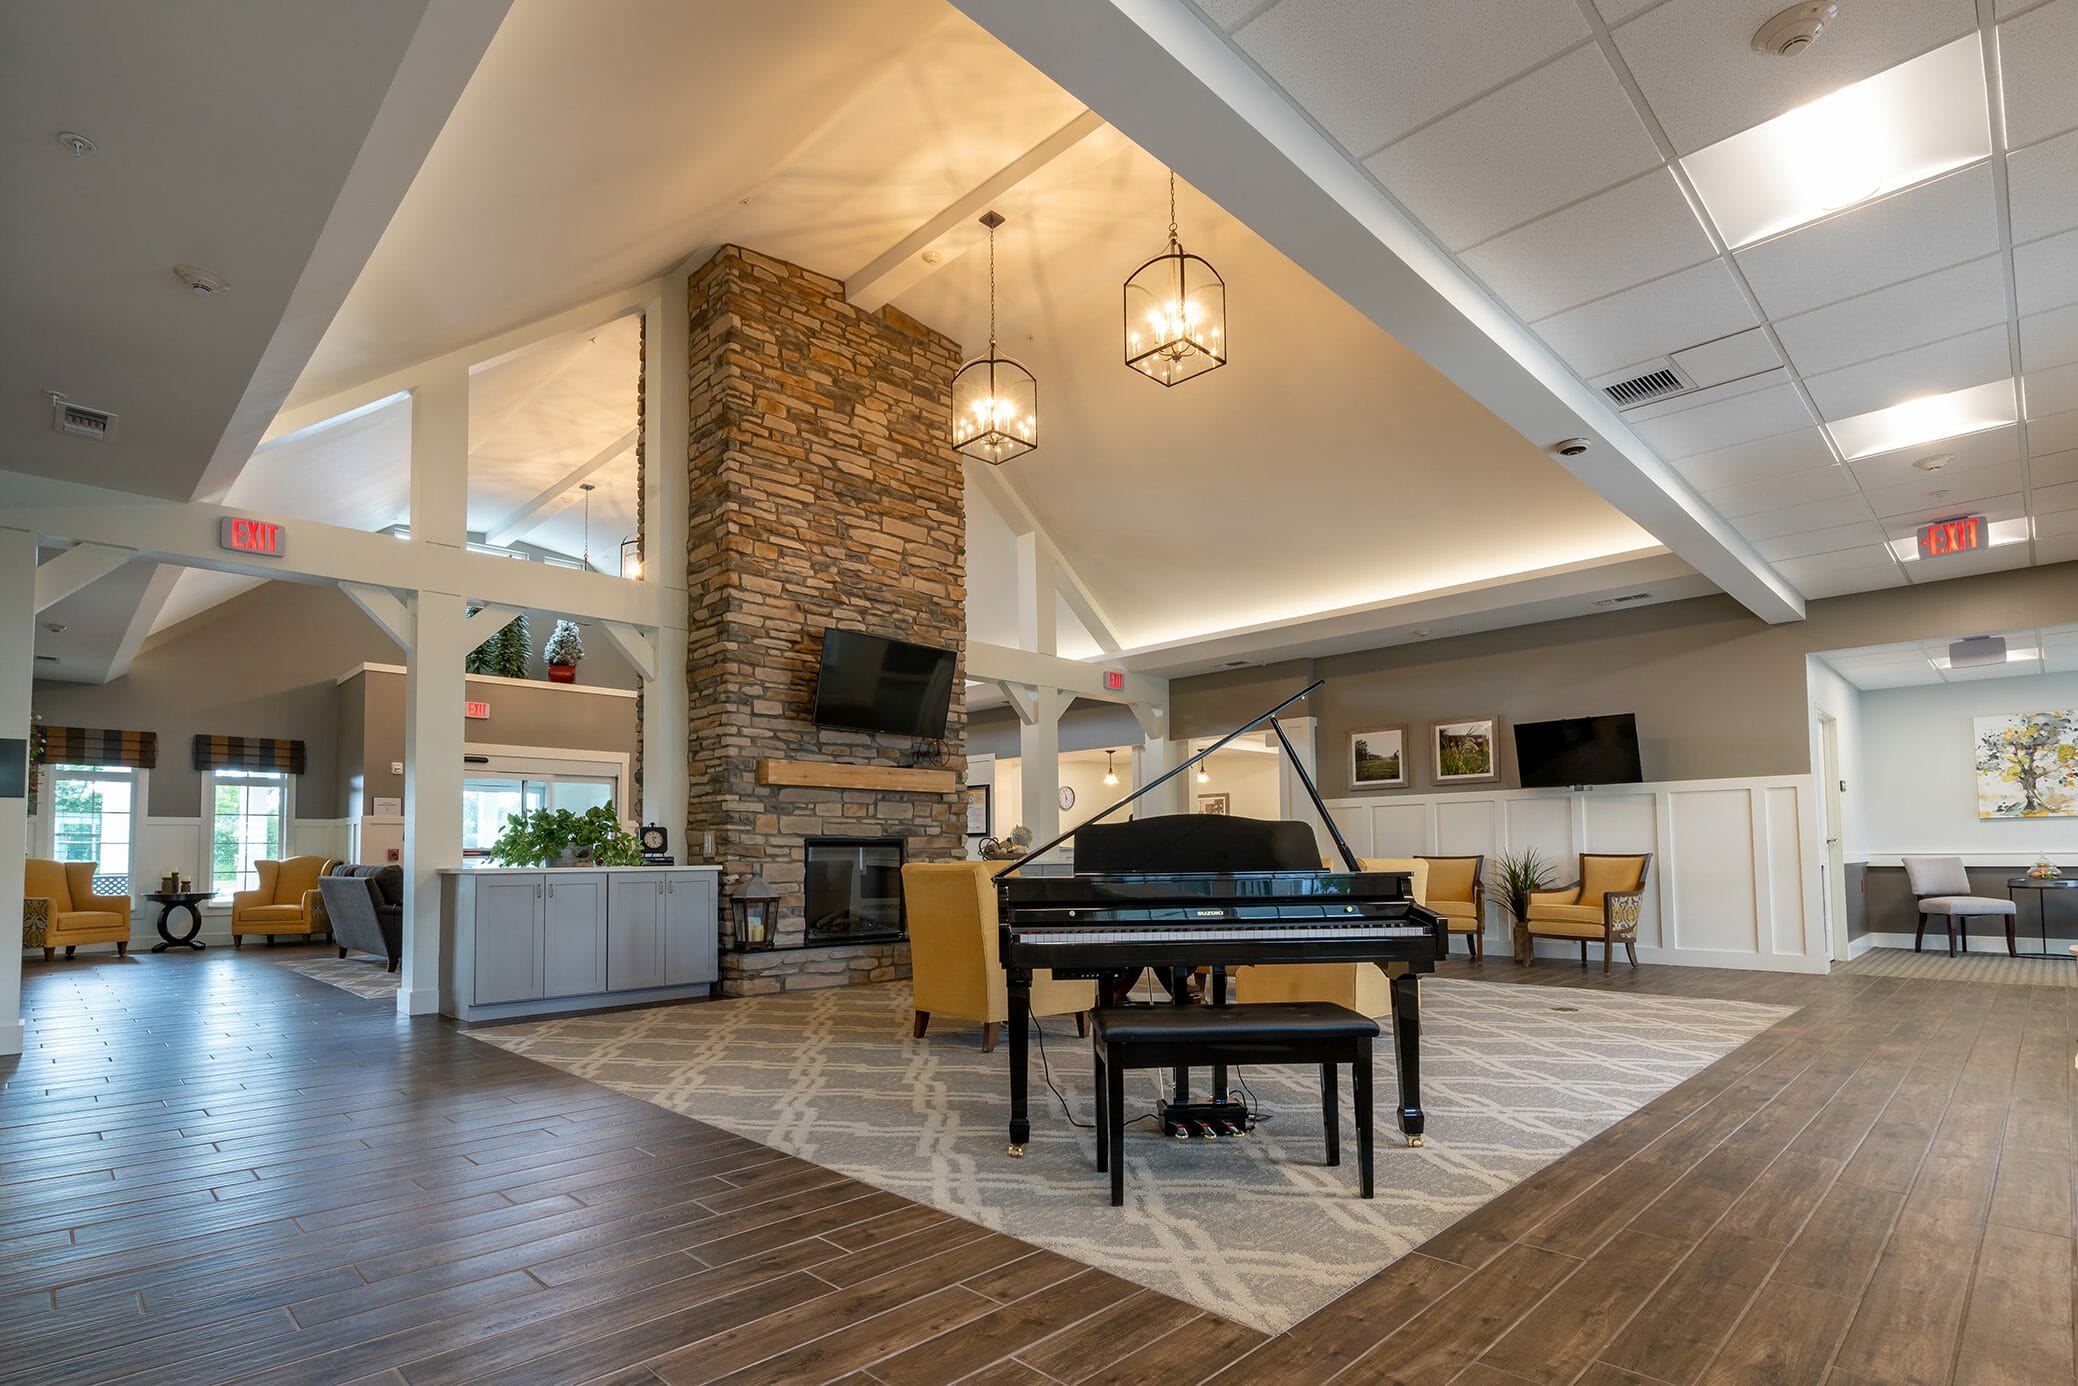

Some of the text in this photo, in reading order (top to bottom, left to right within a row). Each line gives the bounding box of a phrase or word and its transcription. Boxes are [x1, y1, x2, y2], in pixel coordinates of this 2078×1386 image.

[232, 518, 279, 553] EXIT
[1928, 518, 1979, 556] EXIT
[1109, 671, 1123, 689] EXIT
[467, 702, 487, 718] EXIT
